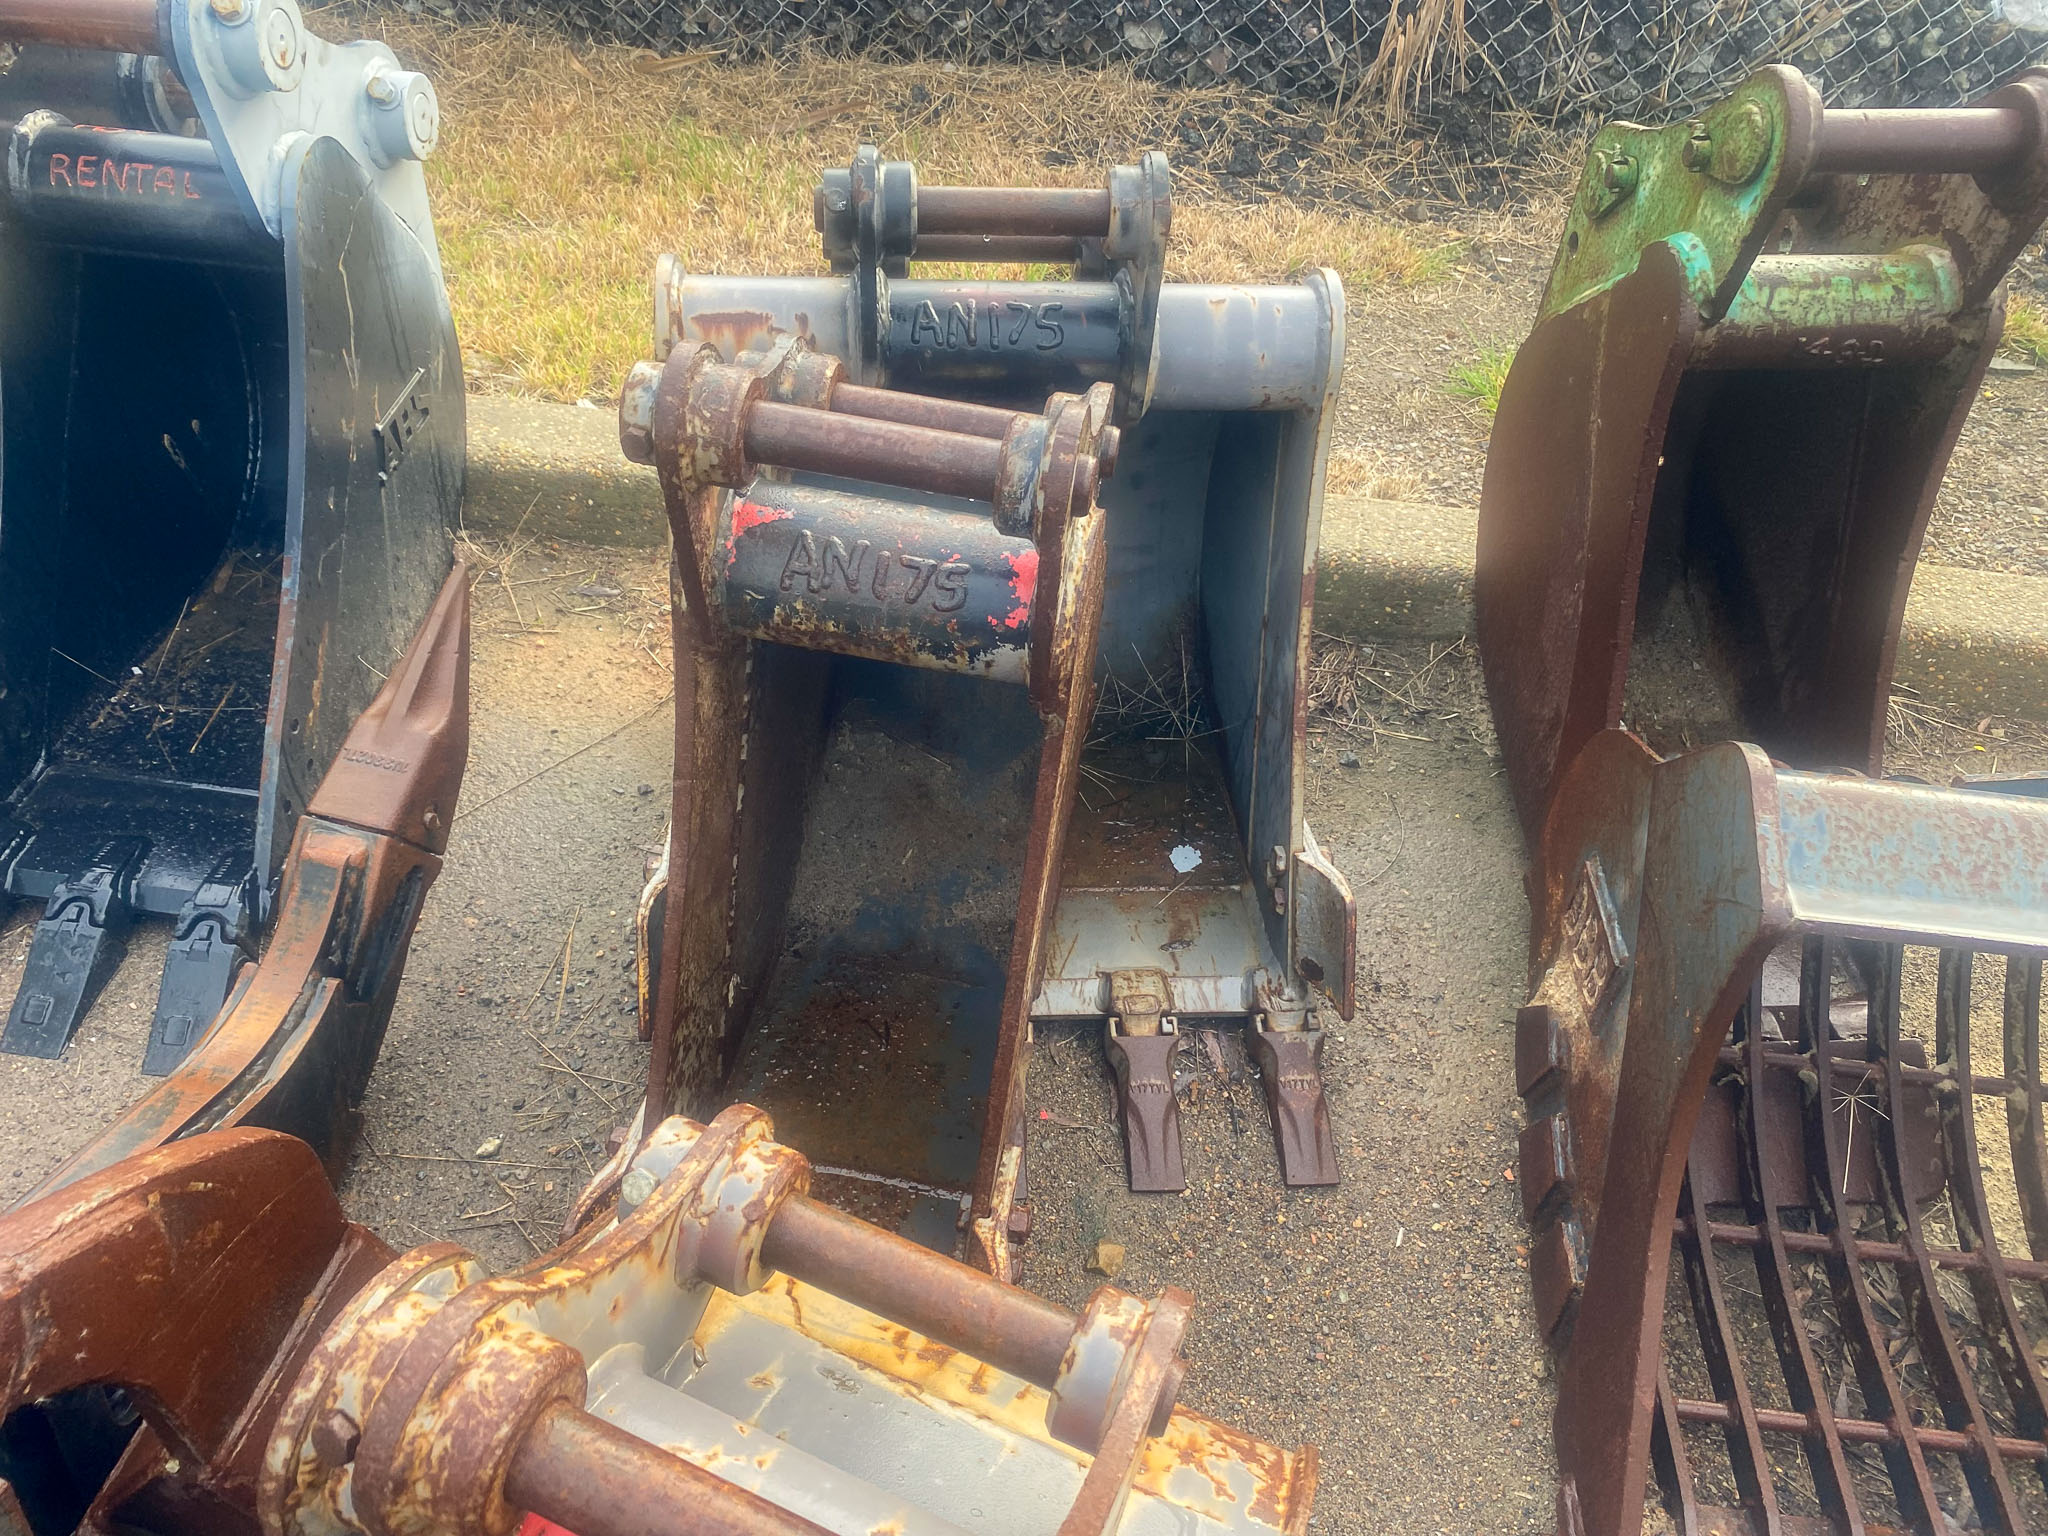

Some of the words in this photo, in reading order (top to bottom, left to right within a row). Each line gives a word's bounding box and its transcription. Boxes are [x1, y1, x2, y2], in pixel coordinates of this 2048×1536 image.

[50, 153, 201, 199] RENTAL
[910, 298, 1065, 351] AN175
[779, 528, 972, 613] AN175
